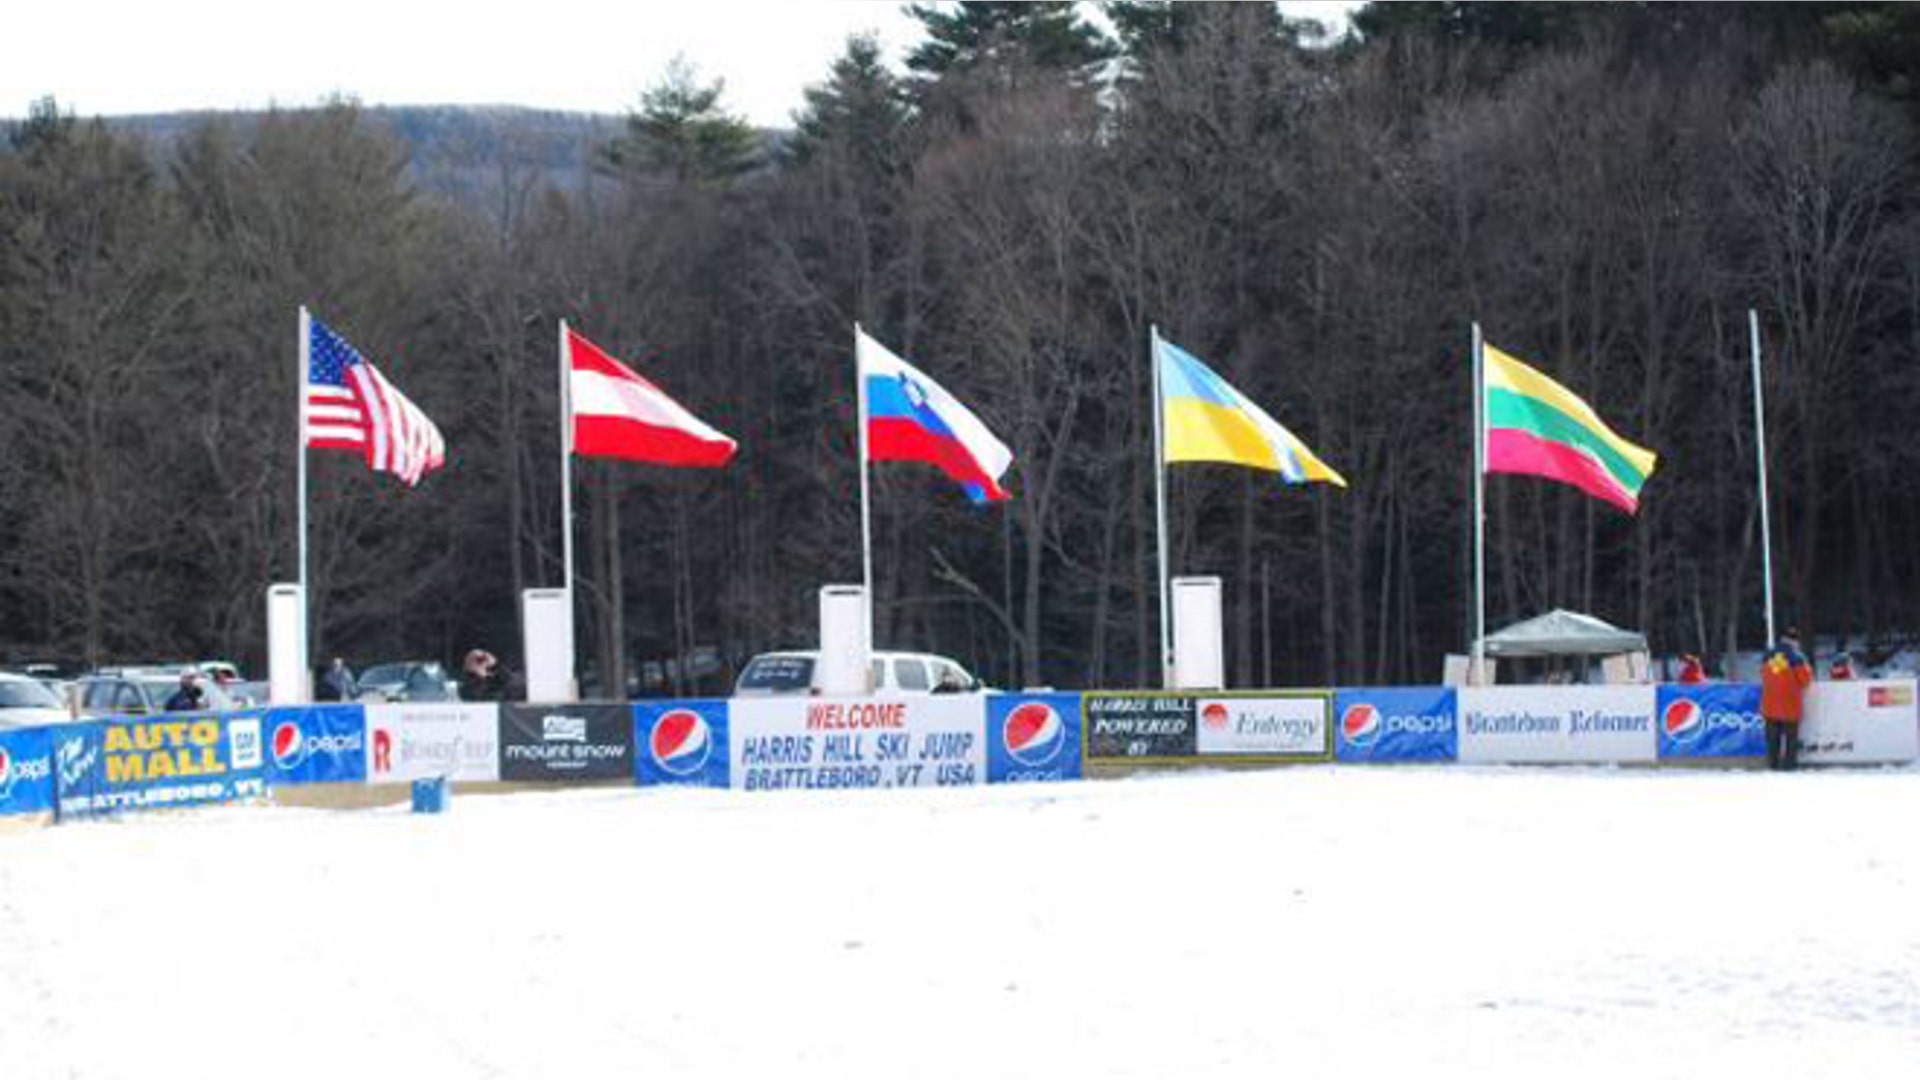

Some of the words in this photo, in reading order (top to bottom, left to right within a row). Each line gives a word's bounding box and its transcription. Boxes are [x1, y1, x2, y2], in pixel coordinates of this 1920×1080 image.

[806, 703, 906, 729] WELCOME
[1154, 698, 1192, 711] HILL
[1095, 718, 1187, 735] POWERED
[1706, 710, 1766, 732] peps
[104, 721, 219, 750] AUTO
[307, 730, 362, 756] pepsi
[742, 735, 814, 764] HARRIS
[823, 734, 863, 762] HILL
[876, 733, 910, 761] SKI
[919, 732, 973, 760] JUMP
[505, 742, 570, 760] mount
[573, 744, 626, 759] snow
[107, 748, 226, 782] MALL
[936, 763, 976, 787] USA
